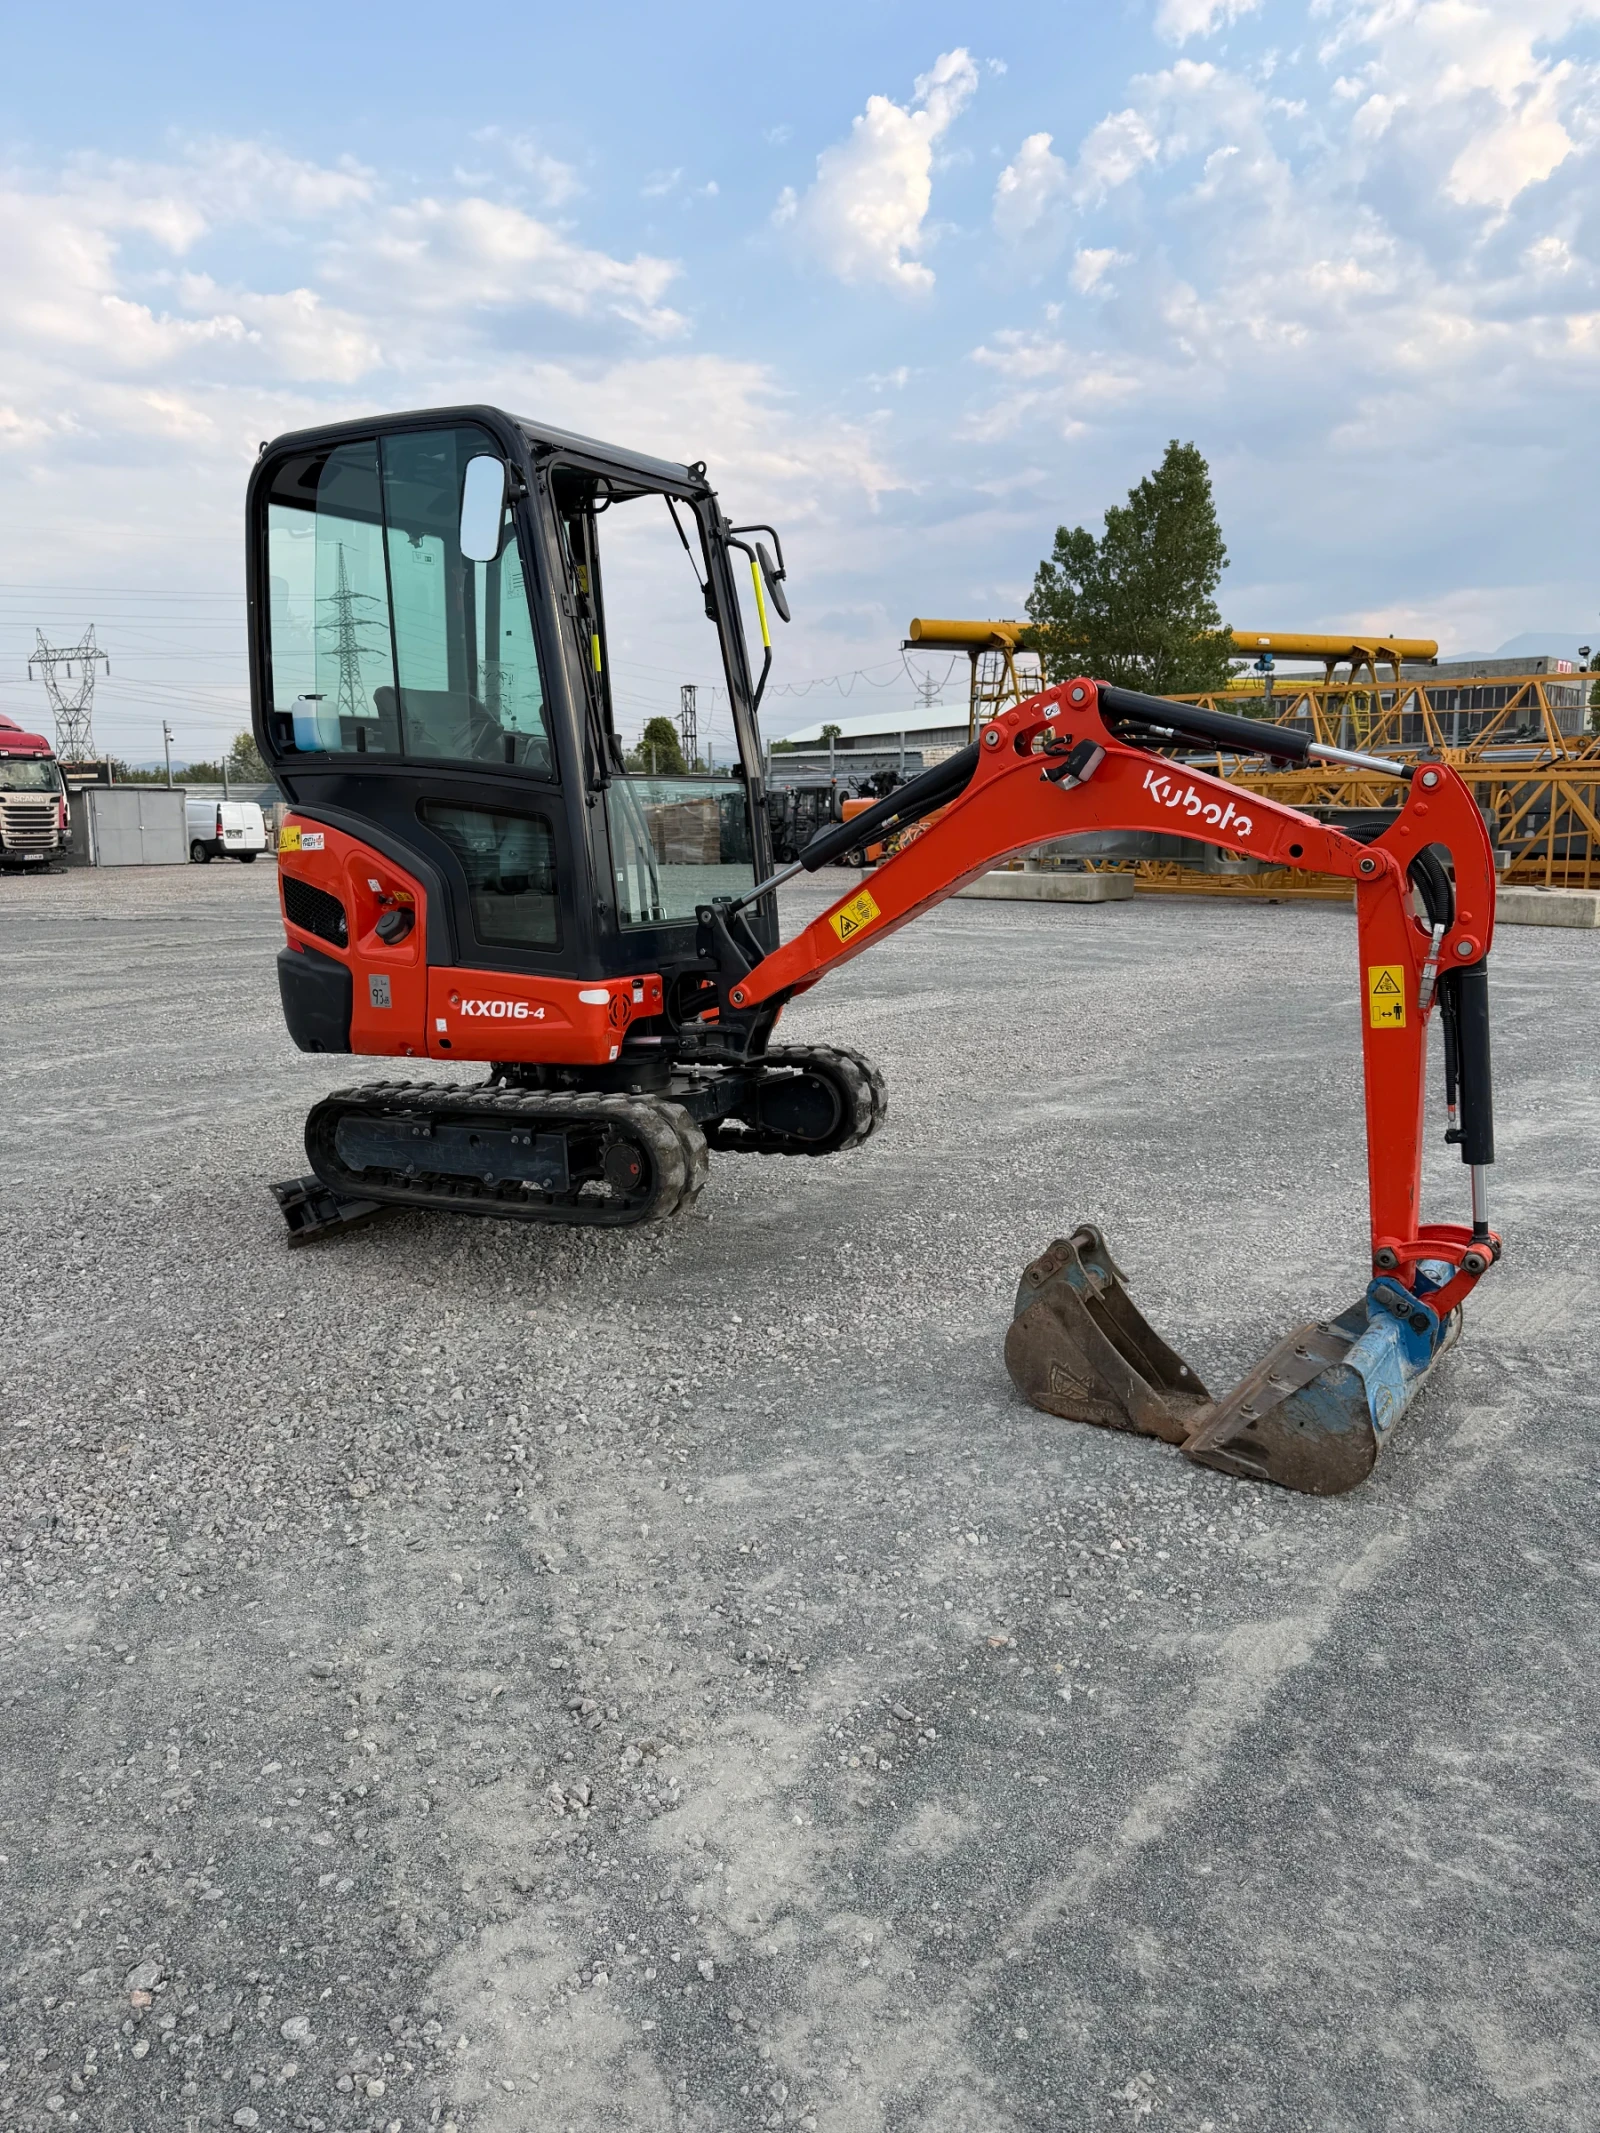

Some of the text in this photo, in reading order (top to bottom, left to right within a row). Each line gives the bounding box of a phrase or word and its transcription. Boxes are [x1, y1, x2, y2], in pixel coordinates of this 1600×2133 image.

[13, 795, 44, 803] SCANIA
[1142, 769, 1253, 837] Kubota
[372, 988, 384, 1004] 93
[460, 999, 546, 1020] KX016-4
